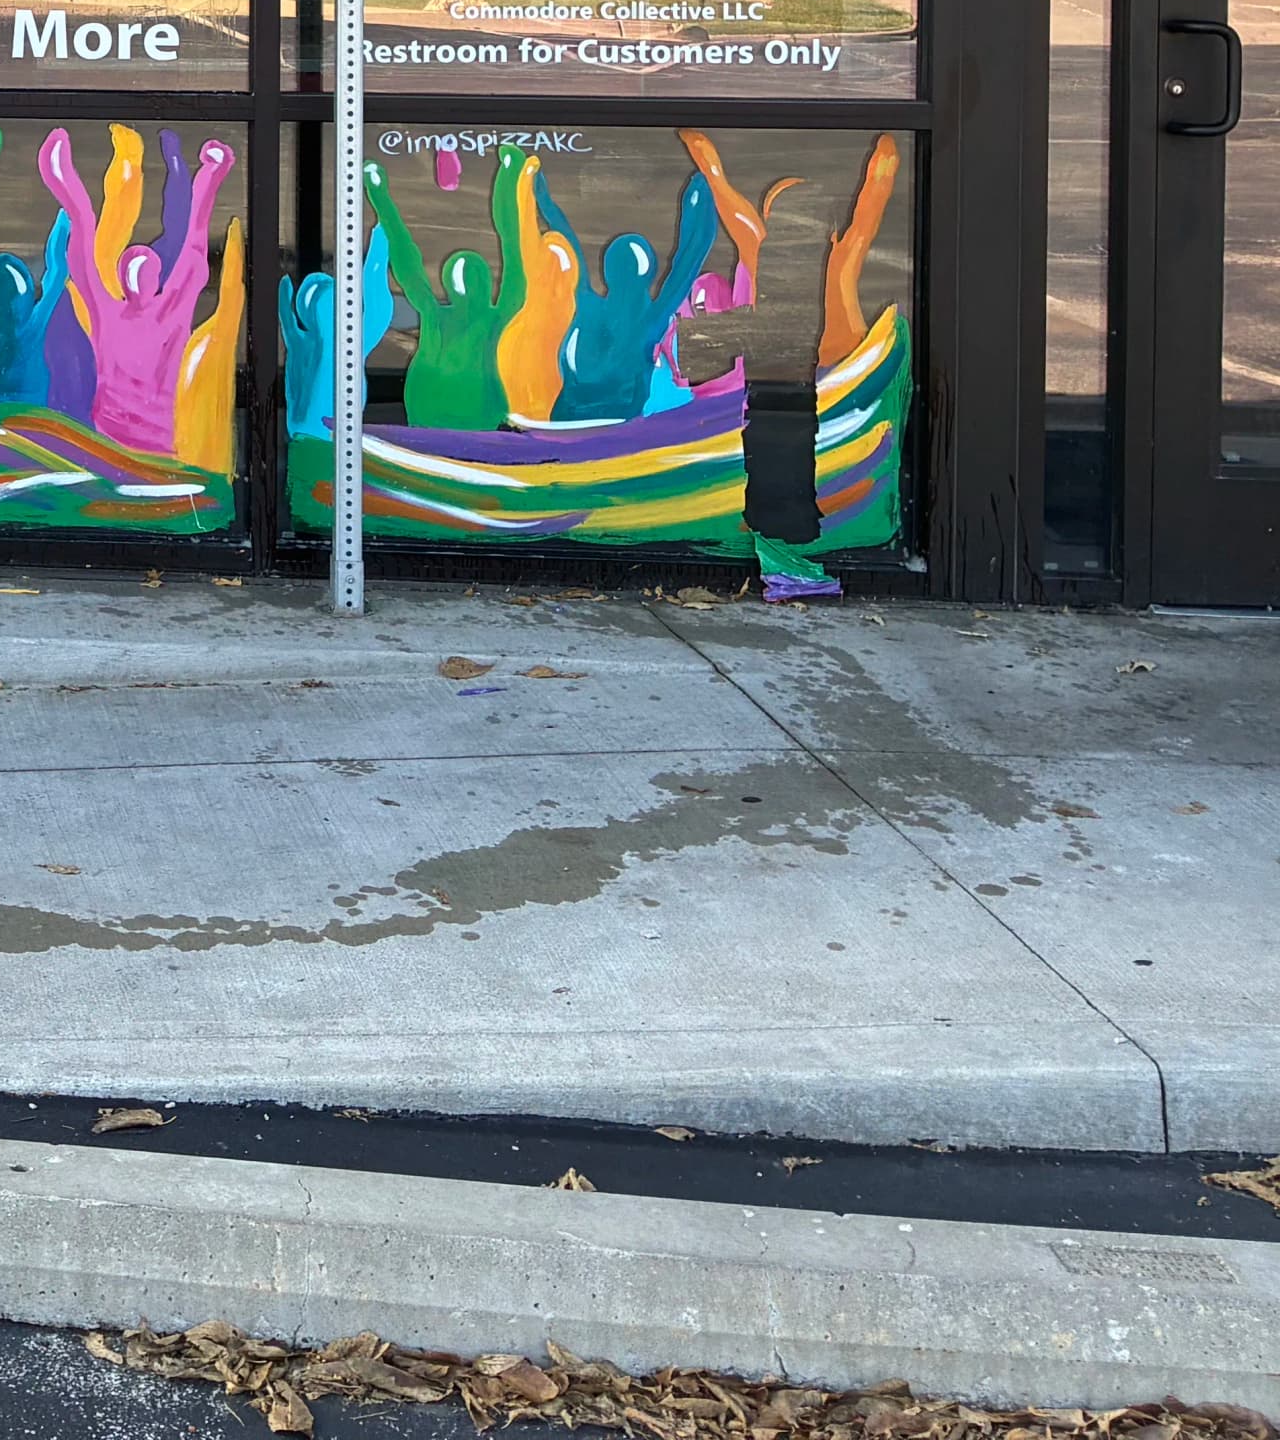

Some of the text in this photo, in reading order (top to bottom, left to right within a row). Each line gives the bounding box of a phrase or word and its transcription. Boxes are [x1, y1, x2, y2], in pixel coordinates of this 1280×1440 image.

[449, 0, 765, 20] Commodore Collective LLC
[11, 9, 180, 60] More
[363, 37, 841, 71] Restroom for Customers Only
